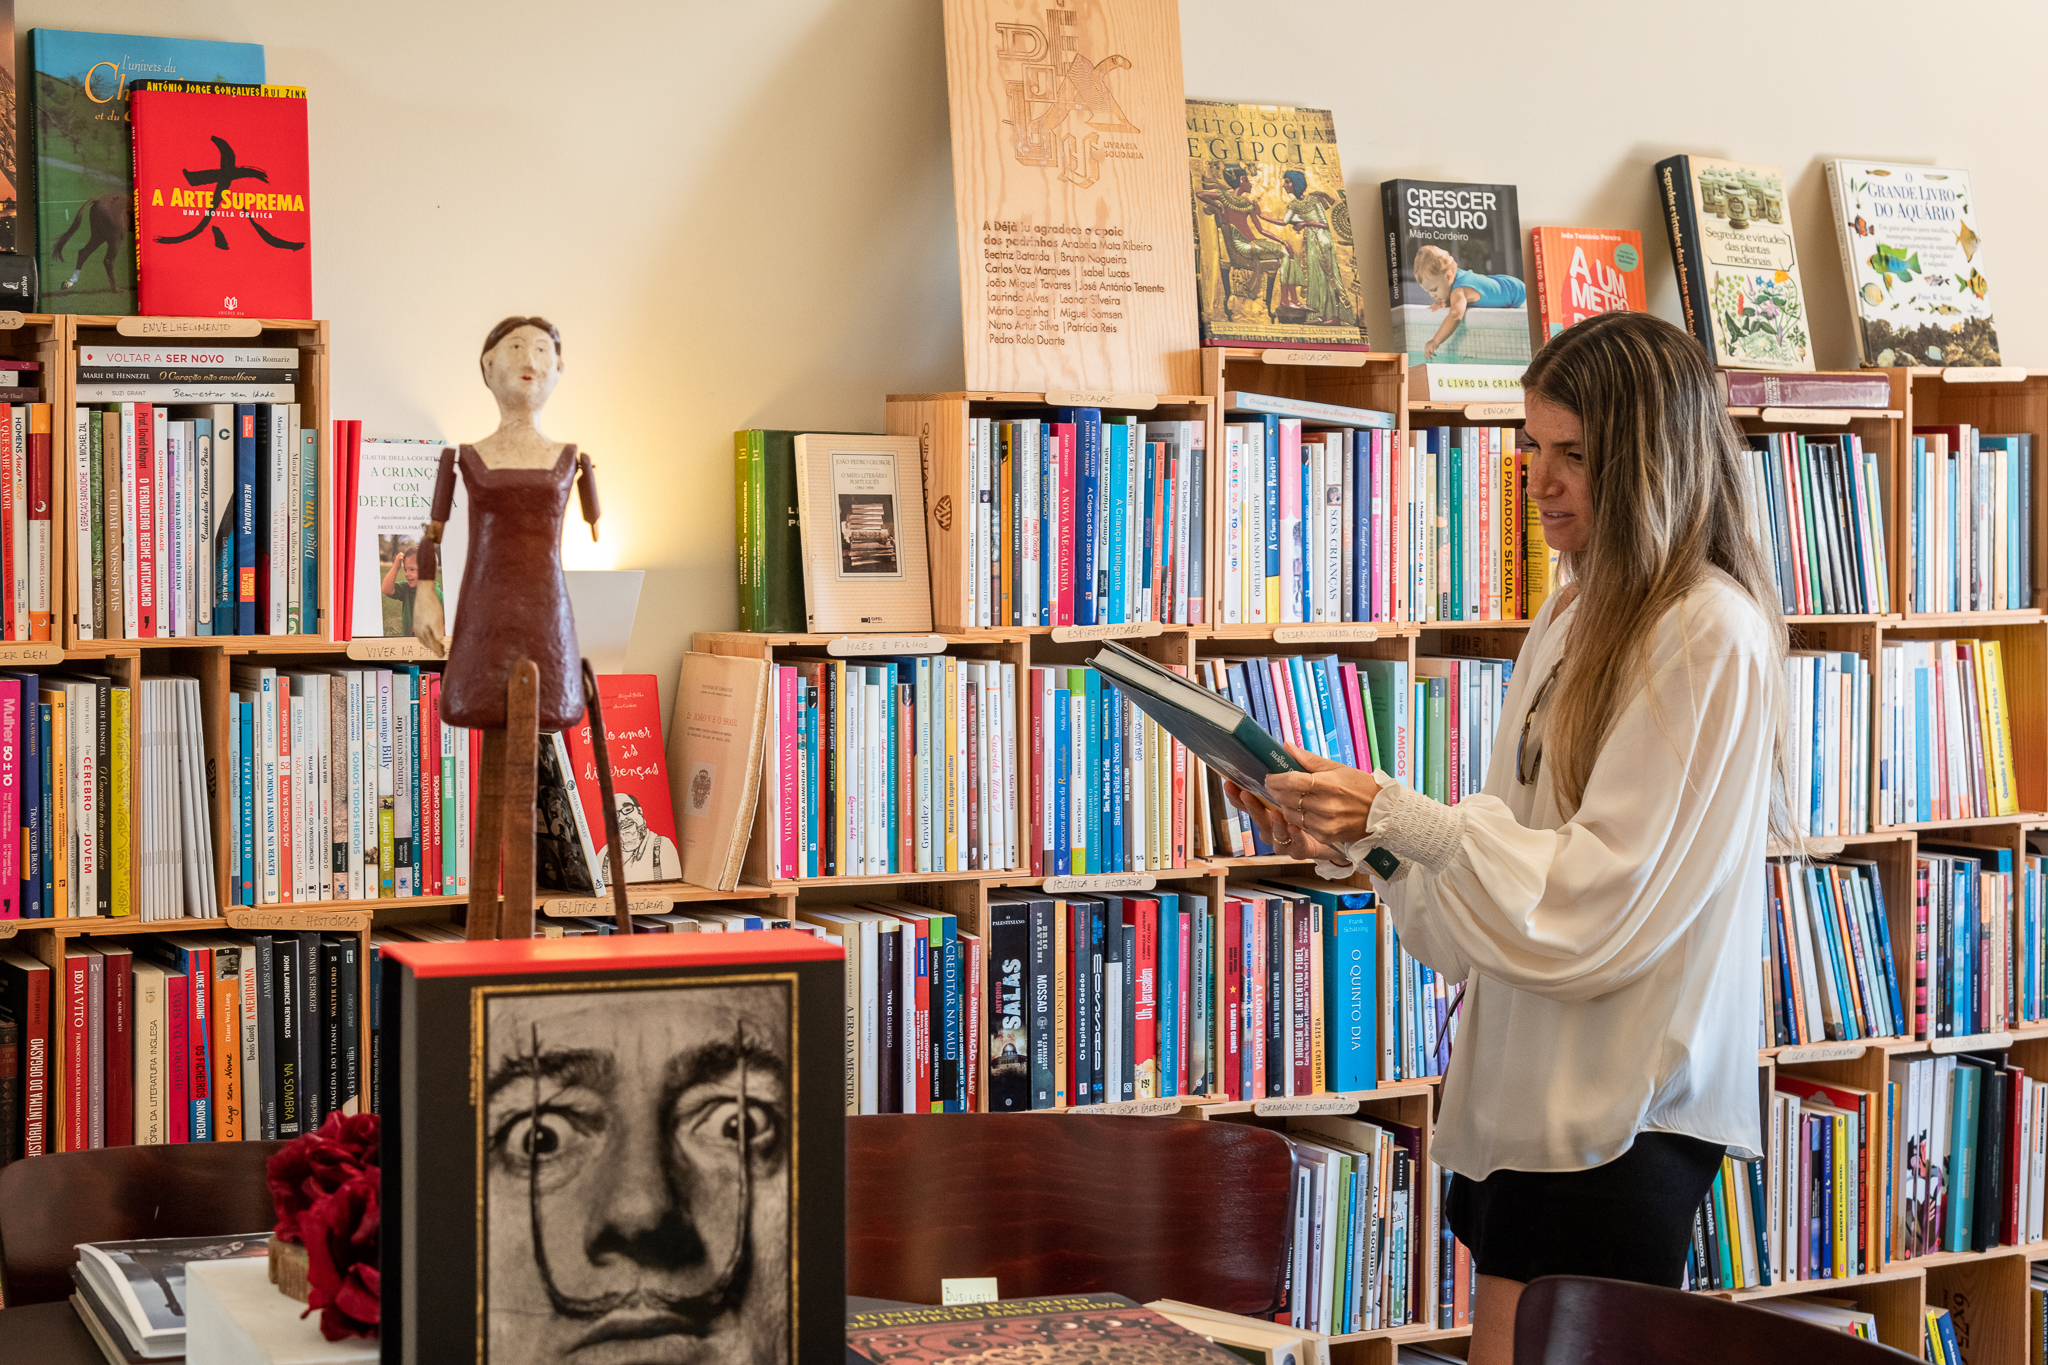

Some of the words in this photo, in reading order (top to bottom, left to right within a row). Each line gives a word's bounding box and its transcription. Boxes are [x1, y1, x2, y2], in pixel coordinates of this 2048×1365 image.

[122, 55, 162, 73] l'univers
[164, 62, 176, 73] du
[147, 80, 183, 92] ANTÓNIO
[186, 83, 212, 94] JORGE
[214, 84, 260, 97] GONÇALVES
[263, 87, 281, 97] RUI
[285, 88, 307, 98] ZINK
[1186, 117, 1327, 140] MITOLOGIA
[1104, 141, 1137, 150] LIVRARIA
[1104, 150, 1144, 160] SOLIDÁRIA
[1188, 137, 1328, 165] EGÍPCIA
[1905, 172, 1912, 183] O
[152, 189, 164, 206] A
[171, 188, 214, 208] ARTE
[221, 190, 304, 212] SUPREMA
[1407, 188, 1497, 210] CRESCER
[1867, 183, 1916, 200] GRANDE
[1919, 185, 1955, 202] LIVRO
[204, 210, 235, 218] NOVELA
[239, 209, 273, 219] GRÁFICA
[1408, 209, 1487, 230] SEGURO
[1874, 202, 1893, 218] DO
[1897, 200, 1955, 221] AQUÁRIO
[983, 221, 991, 231] A
[994, 220, 1018, 236] Déjà
[1022, 221, 1030, 233] lu
[1034, 223, 1082, 238] agradece
[1095, 226, 1124, 240] apoio
[1409, 229, 1431, 239] Mário
[1433, 231, 1468, 241] Cordeiro
[1705, 227, 1745, 242] Segredos
[1751, 232, 1786, 245] virtudes
[983, 235, 1002, 247] dos
[1006, 235, 1058, 252] padrinhos
[1061, 239, 1097, 250] Anabela
[1099, 240, 1120, 251] Mota
[1123, 240, 1152, 251] Ribeiro
[1725, 242, 1739, 251] das
[1742, 244, 1770, 255] plantas
[985, 249, 1014, 261] Beatriz
[1017, 250, 1049, 262] Batarda
[1061, 252, 1085, 264] Bruno
[1088, 254, 1127, 267] Nogueira
[1727, 254, 1771, 267] medicinais
[1570, 246, 1592, 284] A
[1596, 259, 1627, 299] UM
[1571, 281, 1629, 311] METRO
[106, 353, 153, 363] VOLTAR
[155, 354, 162, 362] A
[166, 354, 188, 363] SER
[191, 354, 224, 363] NOVO
[246, 355, 261, 363] Luís
[159, 371, 168, 380] O
[169, 371, 198, 382] Coração
[220, 372, 257, 381] envelhece
[1438, 378, 1443, 387] O
[1447, 379, 1475, 388] LIVRO
[1478, 379, 1489, 388] DA
[1493, 379, 1523, 389] CRIAN
[371, 467, 378, 476] A
[1505, 457, 1512, 466] O
[393, 482, 419, 492] COM
[142, 486, 151, 530] VERDADEIRO
[244, 484, 252, 534] MEGAMUDANÇA
[1116, 499, 1122, 507] A
[1504, 472, 1512, 545] PARADOXO
[1115, 509, 1123, 541] Criança
[143, 531, 151, 559] REGIME
[1114, 544, 1122, 591] Inteligente
[1329, 538, 1337, 600] CRIANÇAS
[1504, 550, 1512, 602] SEXUAL
[142, 561, 151, 606] ANTICANCRO
[618, 726, 652, 739] amor
[83, 757, 92, 812] CÉREBRO
[2001, 767, 2009, 799] Quando
[283, 796, 289, 805] DA
[921, 805, 929, 849] Gravidez
[84, 833, 92, 874] JOVEM
[291, 915, 296, 924] E
[1344, 925, 1368, 933] Schätzing
[1351, 949, 1361, 959] O
[945, 937, 956, 1006] ACREDITAR
[1002, 959, 1021, 1030] SALAS
[1037, 974, 1047, 1013] MOSSAD
[1136, 967, 1153, 1005] Jerusalém
[1351, 966, 1361, 1022] QUINTO
[1136, 1007, 1152, 1020] Oh
[1255, 1029, 1263, 1070] MARCHA
[1351, 1027, 1361, 1051] DIA
[30, 1038, 44, 1077] ORGASMO
[196, 1046, 205, 1056] OS
[196, 1058, 205, 1098] FICHEIROS
[284, 1063, 294, 1076] NA
[30, 1080, 43, 1090] DO
[27, 1092, 43, 1120] ÍNTIMA
[284, 1079, 294, 1120] SOMBRA
[196, 1100, 206, 1139] SNOWDEN
[1373, 1186, 1378, 1199] TV
[1372, 1212, 1377, 1227] DA
